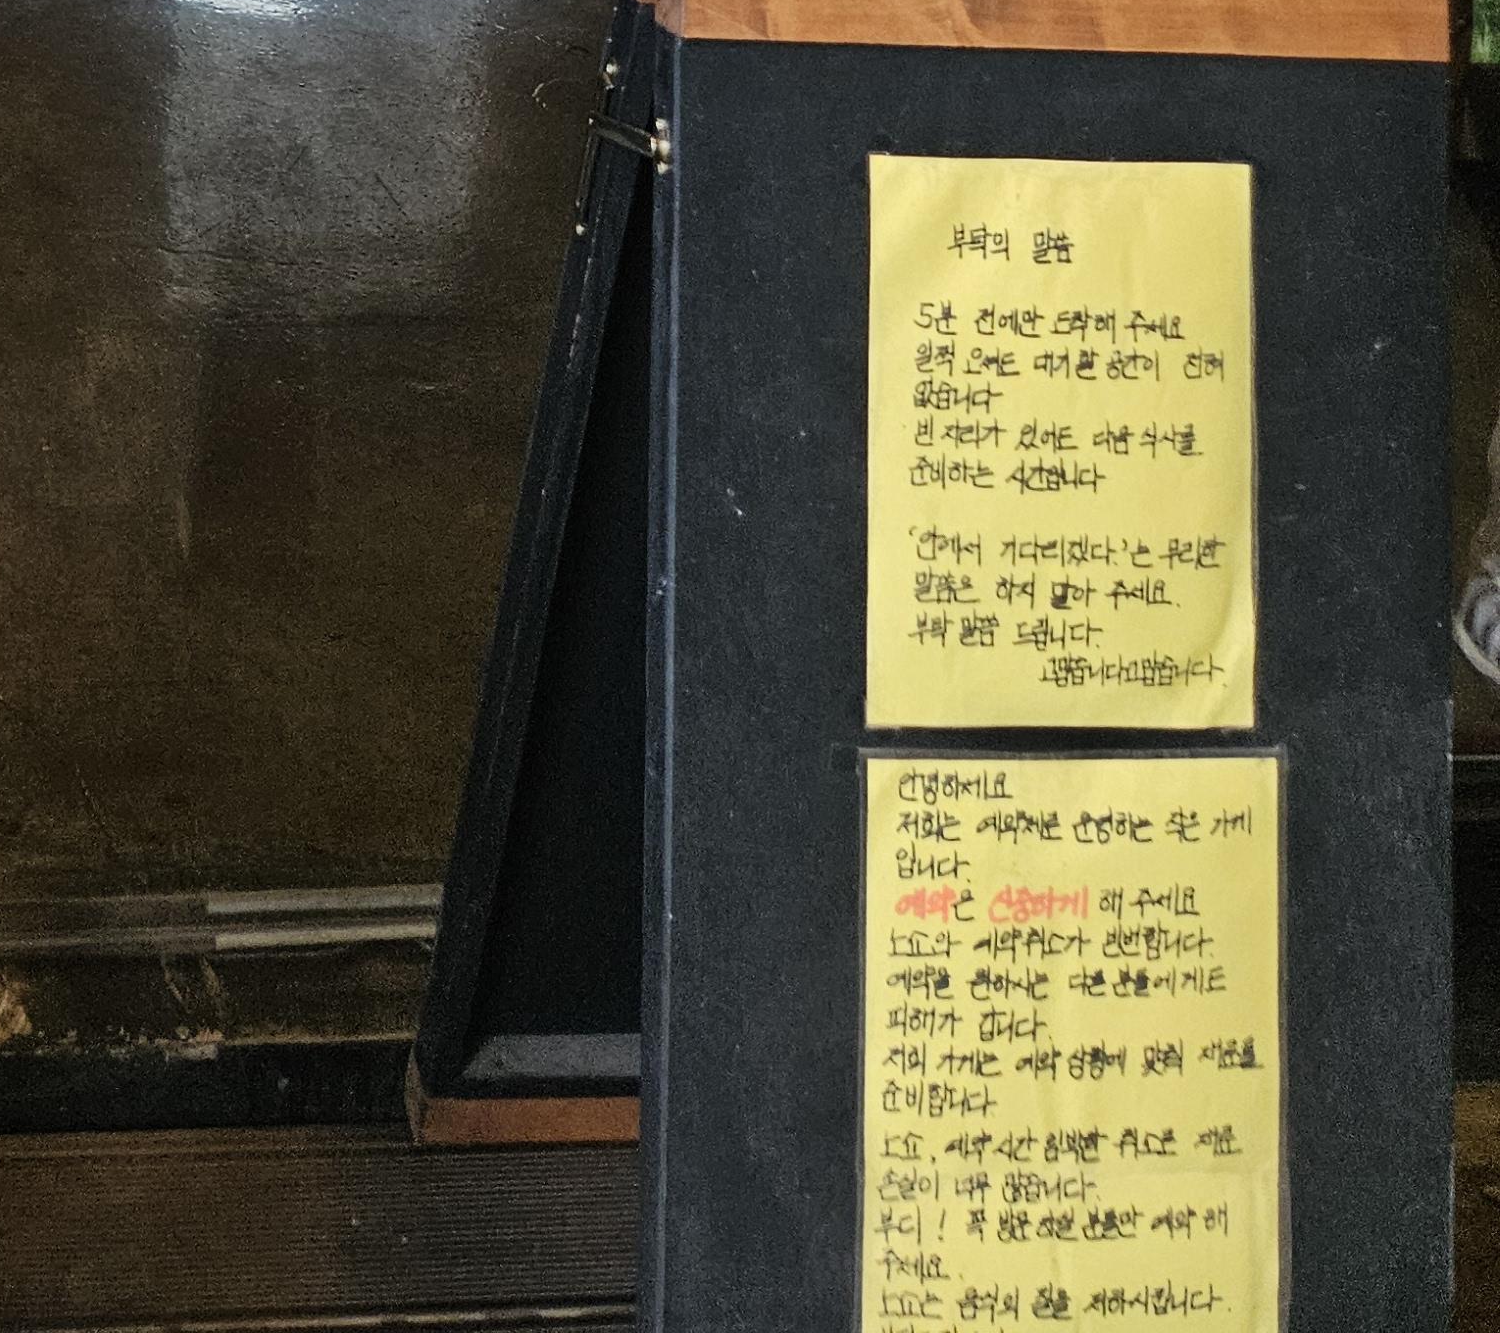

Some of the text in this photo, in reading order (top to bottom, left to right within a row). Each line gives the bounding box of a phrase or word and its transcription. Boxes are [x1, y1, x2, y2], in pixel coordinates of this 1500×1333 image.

[948, 222, 1075, 264] 부탁의 말씀
[914, 300, 1185, 344] 5분 전에만 도착해 주세요
[915, 339, 955, 376] 일찍
[963, 346, 1020, 376] 오셔도
[1106, 348, 1160, 382] 공간이
[1183, 346, 1225, 382] 전혀
[914, 375, 1003, 414] 없습니다
[1015, 418, 1078, 452] 있어도
[1093, 421, 1135, 454] 다음
[1139, 421, 1203, 459] 식사를
[909, 453, 1106, 494] 준비하는 시간입니다
[1159, 534, 1226, 570] 무리한
[914, 565, 981, 603] 말씀은
[996, 572, 1035, 610] 하지
[1051, 574, 1097, 610] 말아
[908, 608, 954, 648] 부탁
[960, 609, 1000, 647] 말씀
[898, 767, 1014, 805] 안녕하세요
[896, 808, 961, 843] 저희는
[1072, 805, 1154, 844] 운영하는
[1164, 805, 1200, 843] 작은
[1210, 804, 1252, 838] 가게
[988, 884, 1089, 923] 신중하게
[1099, 886, 1123, 919] 해
[1129, 883, 1200, 917] 주세요
[888, 927, 962, 959] 노쇼와
[886, 963, 954, 1000] 예약을
[966, 965, 1049, 1000] 원하시는
[886, 1000, 963, 1038] 피해가
[882, 1042, 926, 1076] 저희
[936, 1044, 1003, 1076] 가게는
[1015, 1044, 1062, 1082] 예약
[1067, 1039, 1127, 1080] 상황에
[876, 1166, 939, 1202] 손실이
[955, 1172, 991, 1203] 너무
